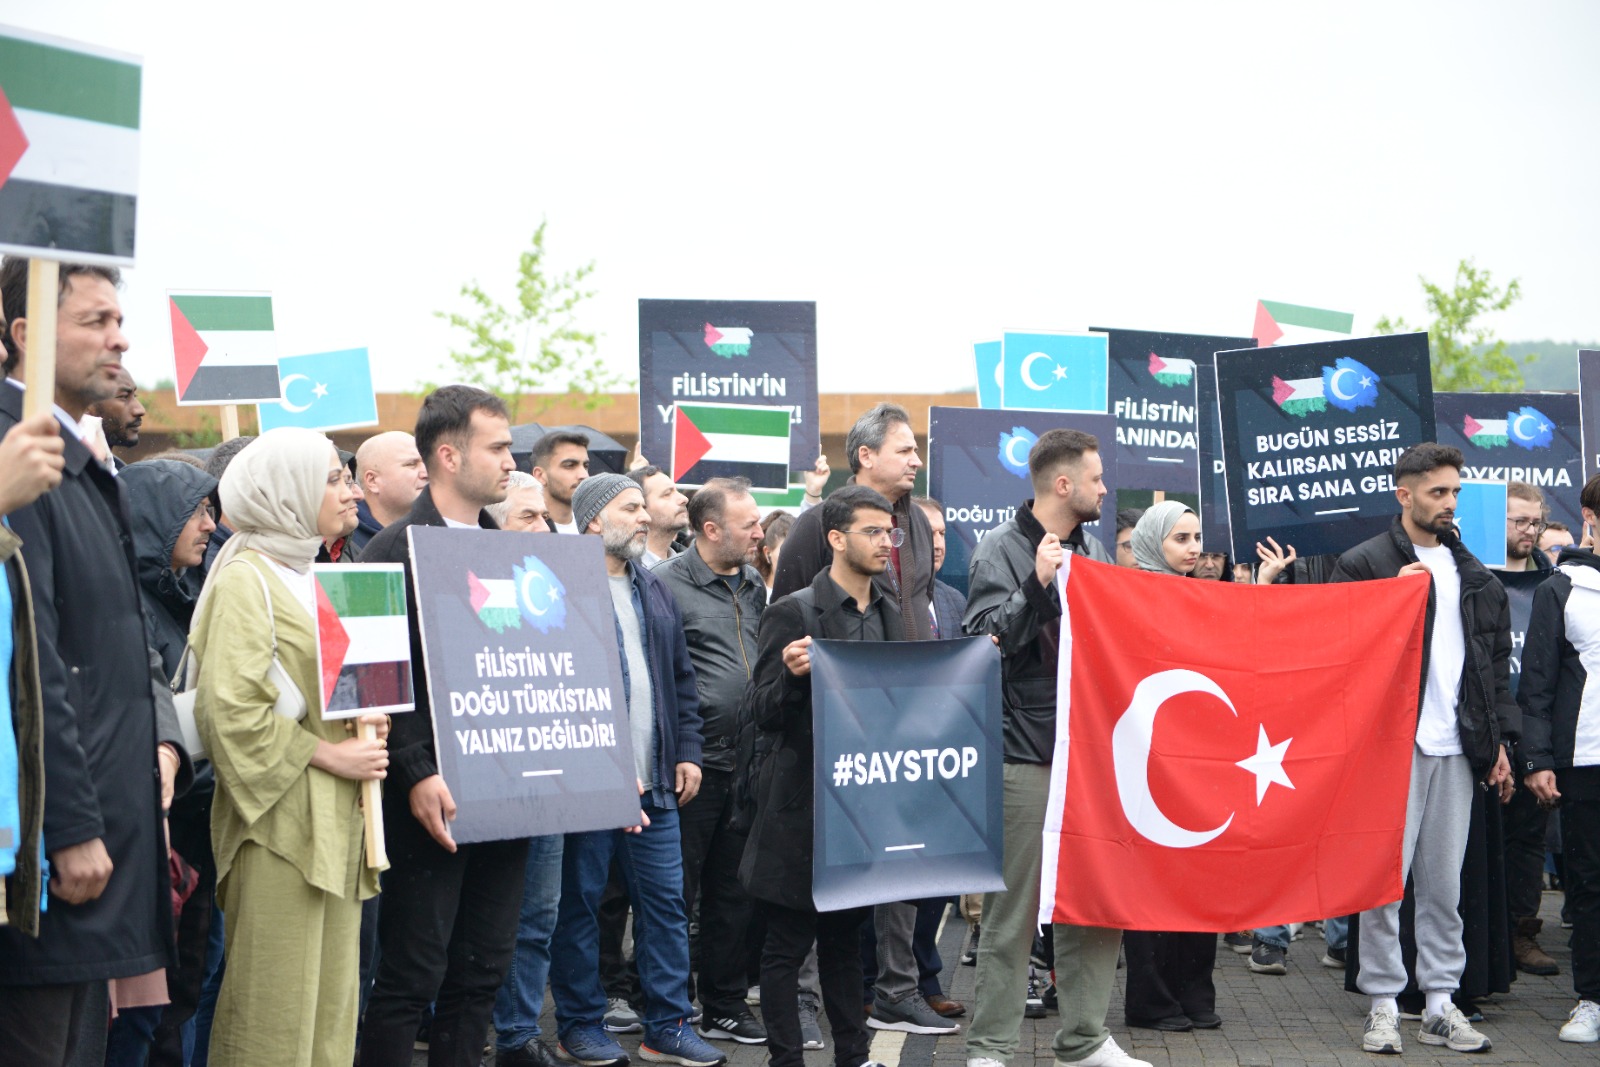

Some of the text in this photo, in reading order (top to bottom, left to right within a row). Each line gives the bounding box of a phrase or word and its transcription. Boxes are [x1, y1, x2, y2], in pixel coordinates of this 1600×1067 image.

[672, 372, 786, 396] FİLİSTİN'İN
[1115, 426, 1199, 450] ANINDA
[1256, 418, 1400, 453] BUGÜN SESSİZ
[1247, 453, 1347, 480] KALIRSAN
[1460, 466, 1573, 487] YKIRIMA
[1247, 474, 1398, 506] SIRA SANA GEL
[946, 505, 993, 523] DOĞU
[475, 646, 575, 678] FİLİSTİN VE
[450, 682, 612, 717] DOĞU TÜRKİSTAN
[455, 717, 616, 756] YALNIZ DEĞİLDİR!
[833, 746, 978, 787] #SAYSTOP
